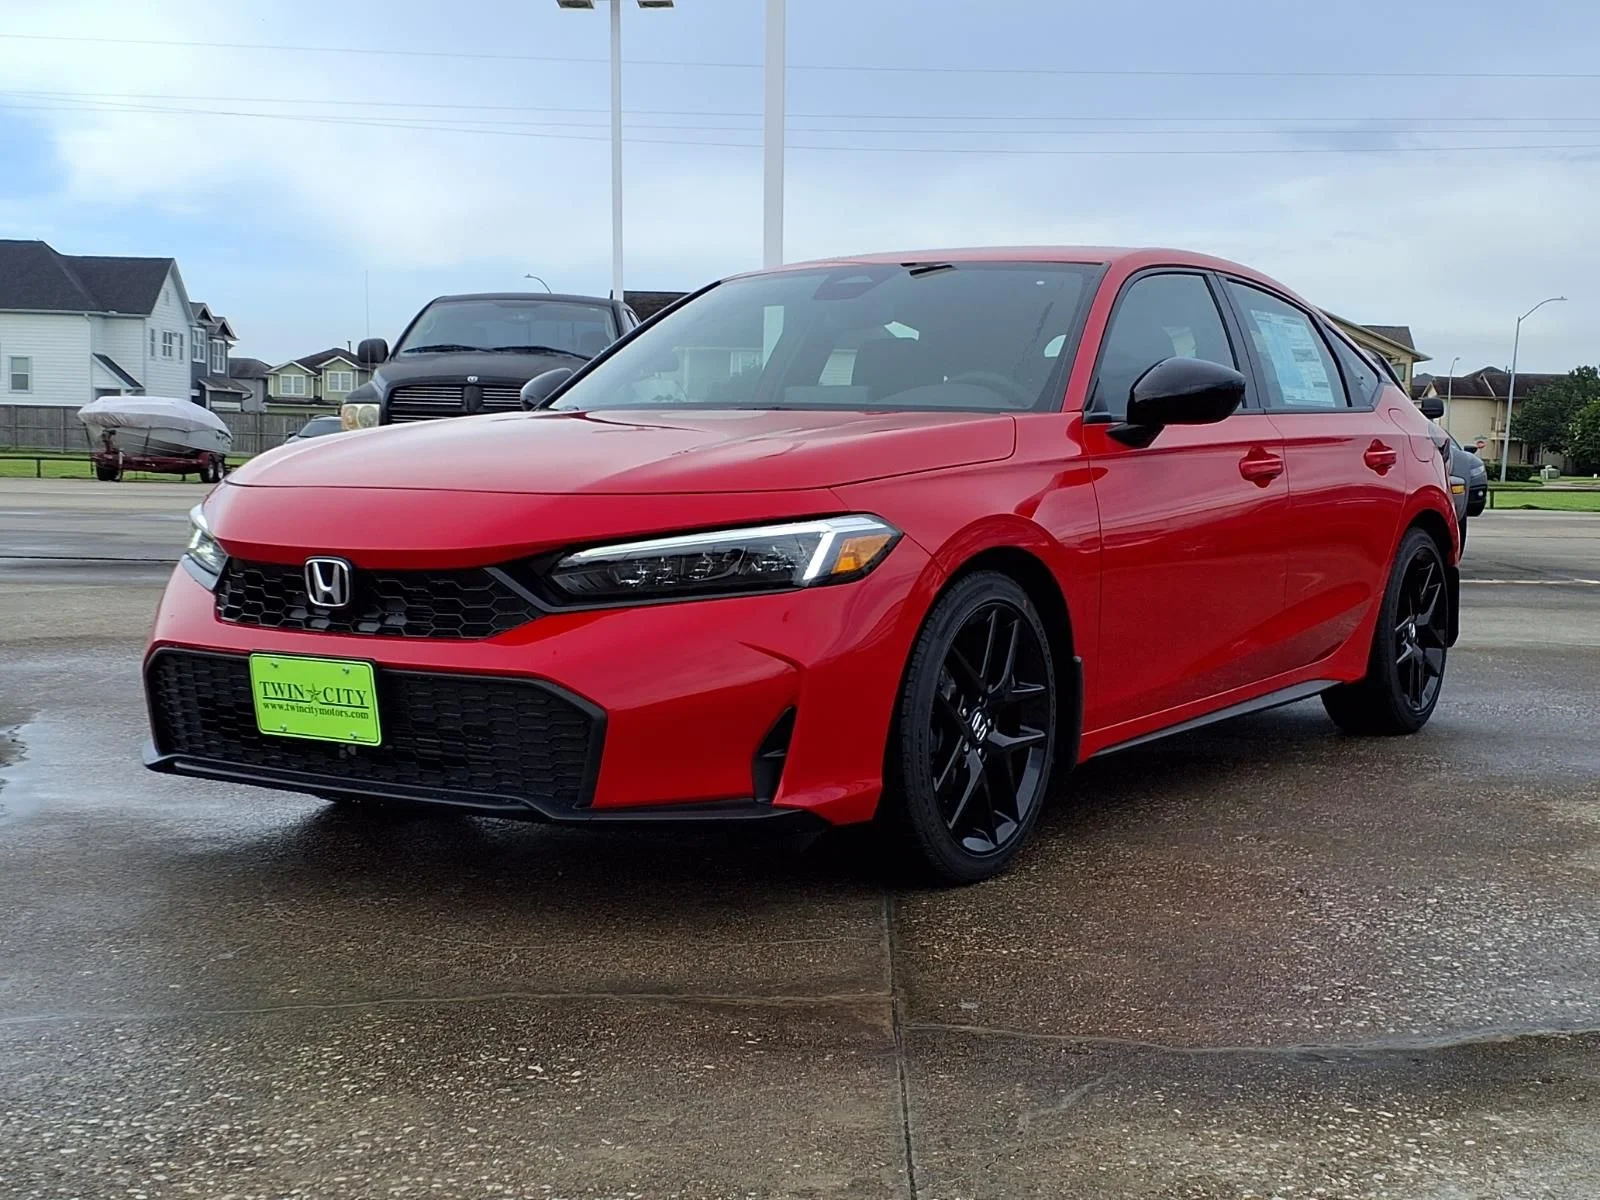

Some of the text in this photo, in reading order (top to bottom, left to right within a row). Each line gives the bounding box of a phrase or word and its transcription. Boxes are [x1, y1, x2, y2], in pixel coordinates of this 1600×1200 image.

[259, 681, 367, 705] TWIN CITY
[263, 702, 369, 719] www.twincitymotors.com
